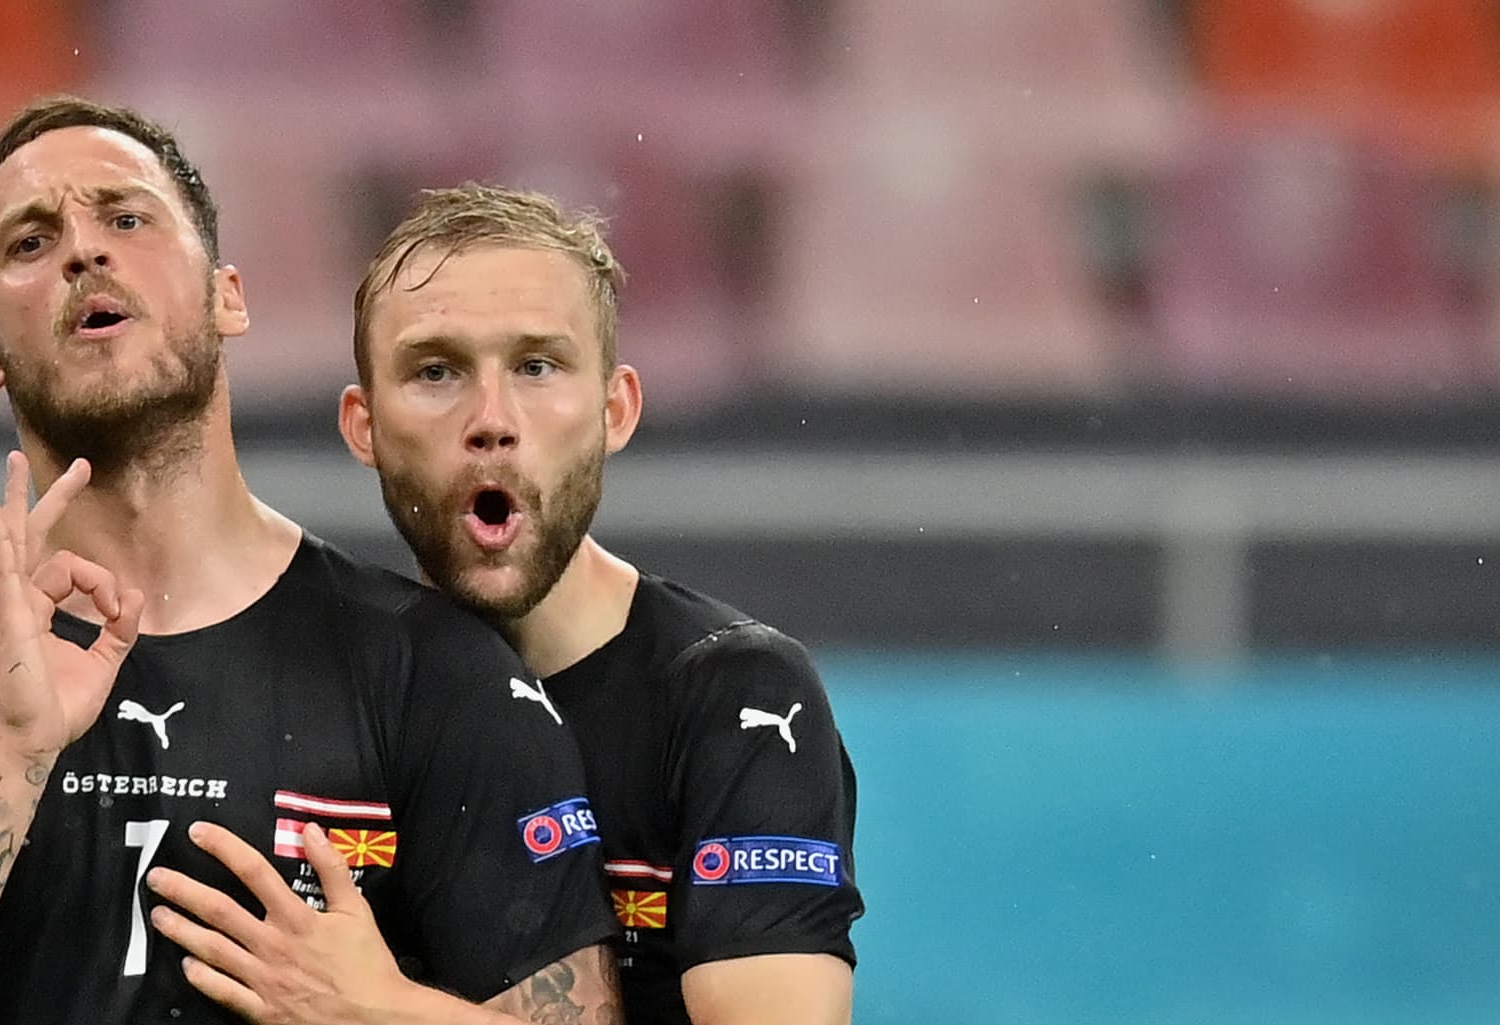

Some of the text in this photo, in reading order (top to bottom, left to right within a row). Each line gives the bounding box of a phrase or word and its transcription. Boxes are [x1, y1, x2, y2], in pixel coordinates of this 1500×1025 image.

[62, 771, 229, 799] ÖSTERREICH
[733, 849, 839, 874] RESPECT
[123, 819, 170, 976] 7
